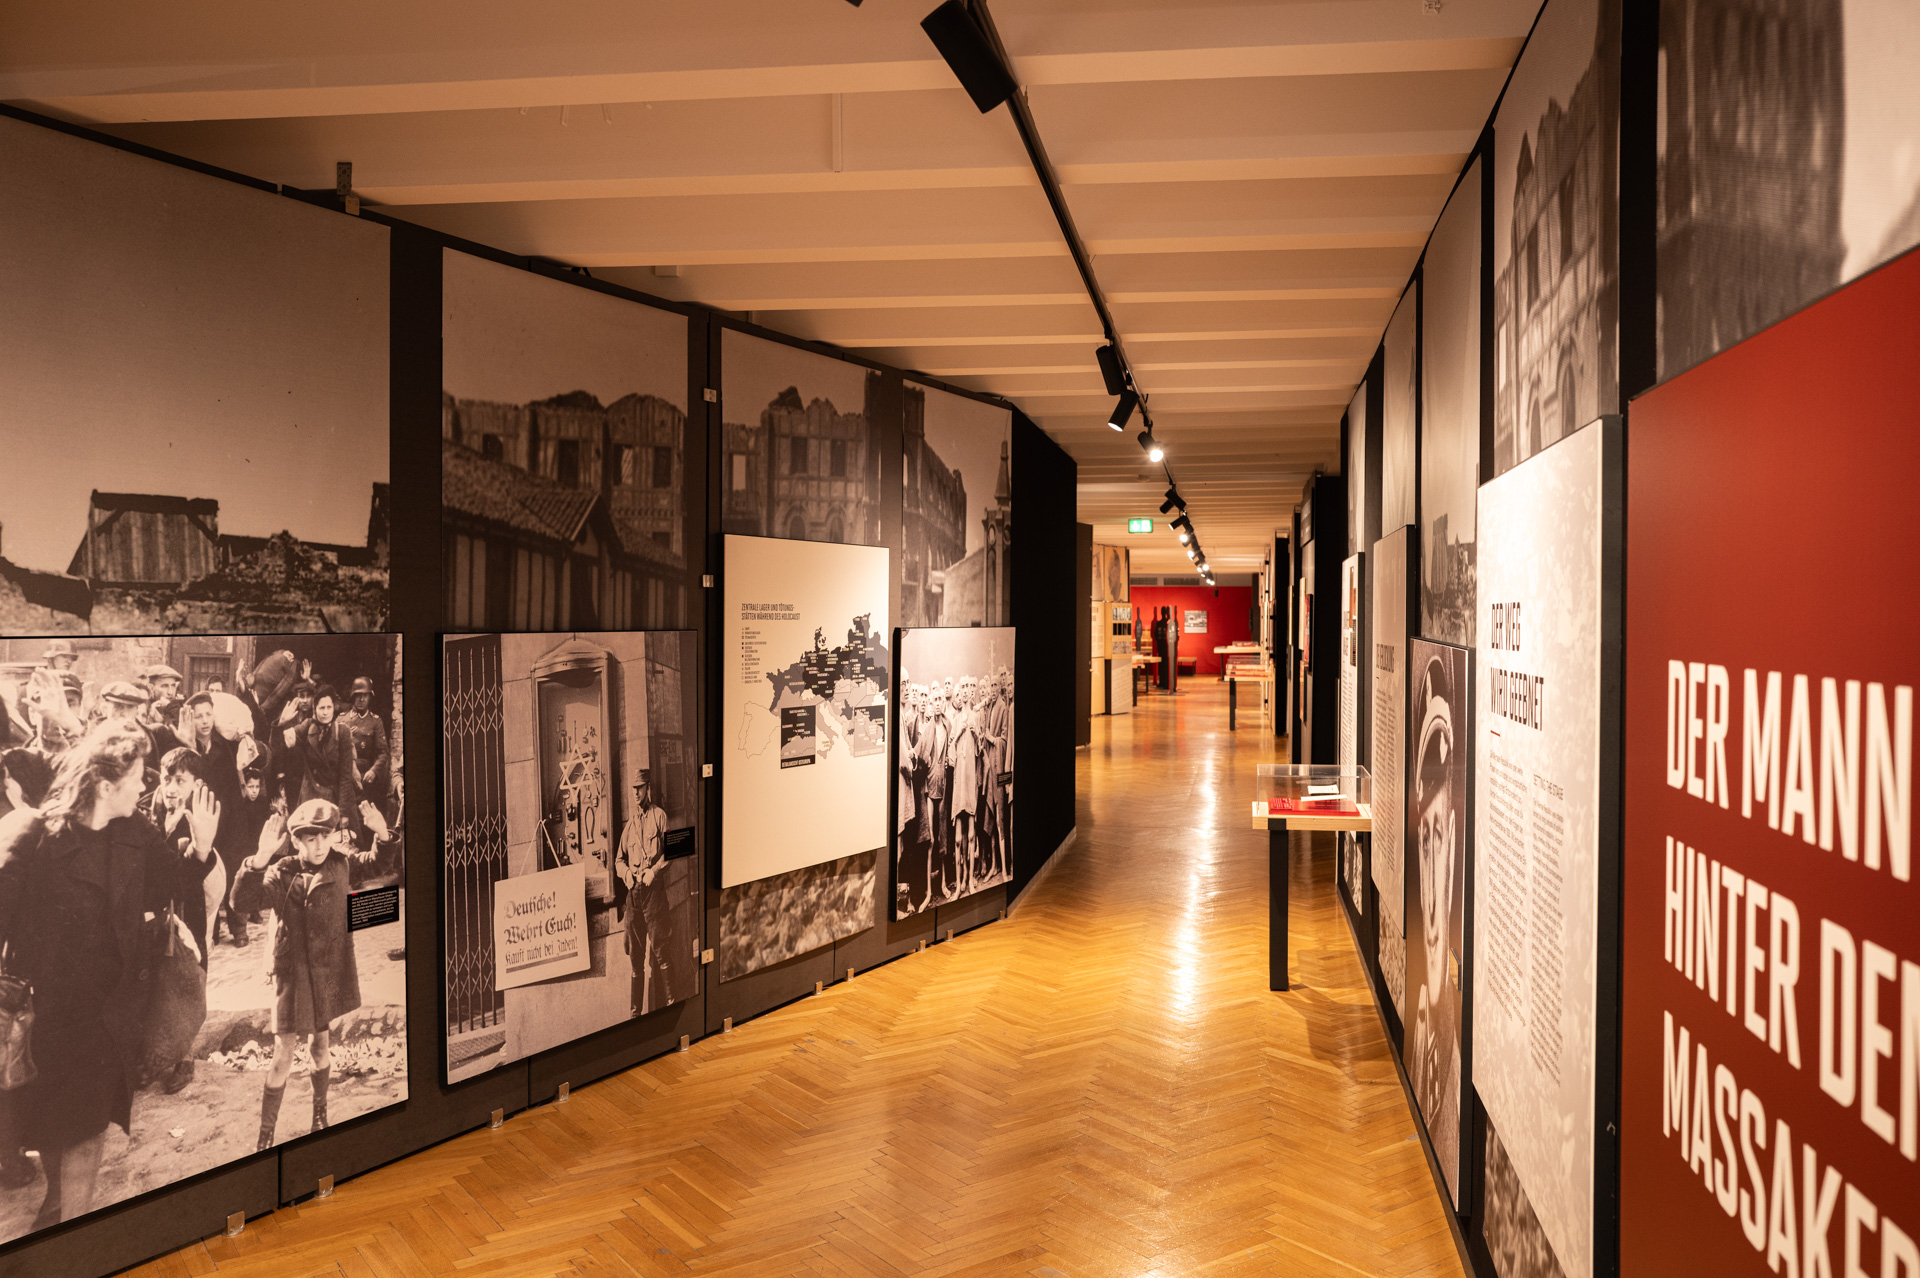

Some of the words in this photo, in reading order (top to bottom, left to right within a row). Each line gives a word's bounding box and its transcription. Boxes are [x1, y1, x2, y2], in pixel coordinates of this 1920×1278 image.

[742, 603, 758, 611] ZENTRALE
[1491, 603, 1503, 649] DER
[1505, 602, 1520, 651] WEG
[1490, 667, 1507, 717] WIRD
[1510, 671, 1544, 731] GEEBNET
[1667, 659, 1729, 810] DER
[1741, 668, 1913, 883] MANN
[504, 920, 543, 945] Wehrt
[545, 912, 577, 936] Euch!
[544, 940, 554, 957] bei
[1664, 835, 1801, 1070] HINTER
[1663, 1009, 1920, 1278] MASSAKE
